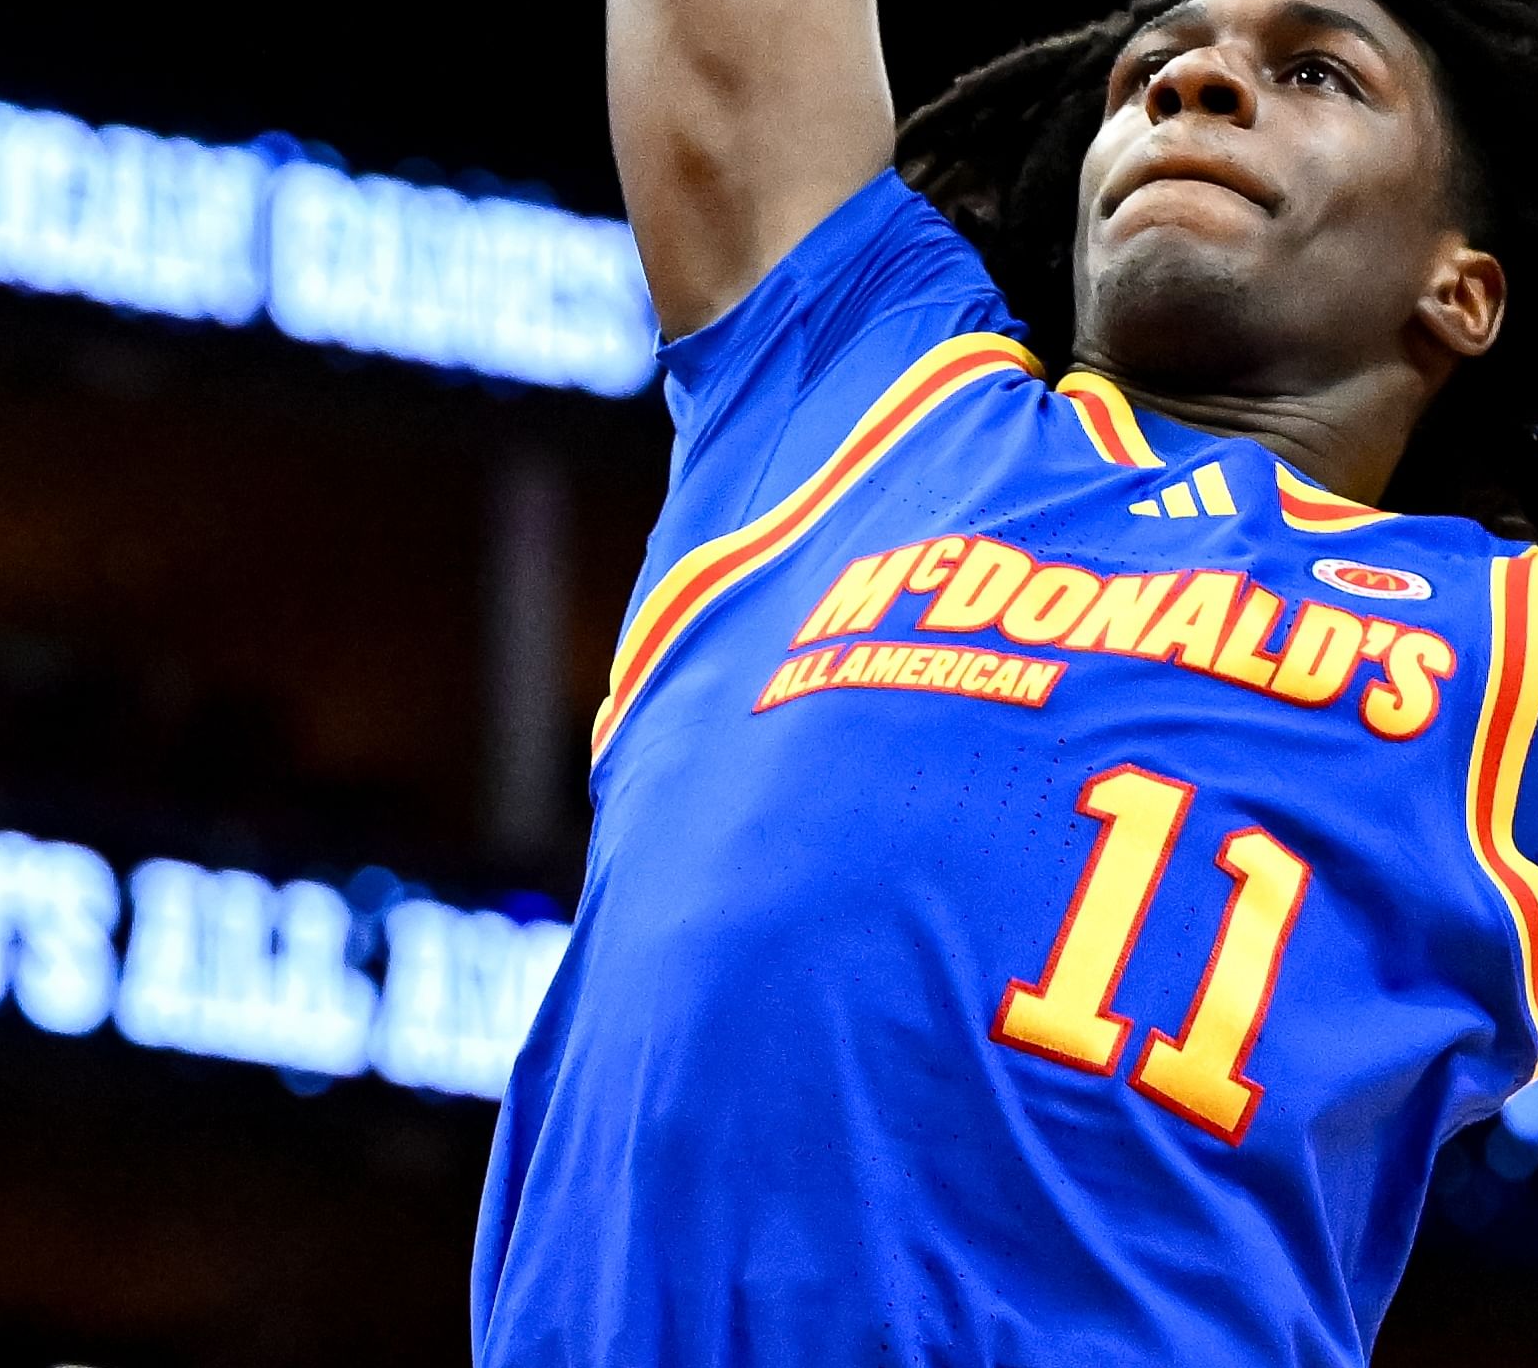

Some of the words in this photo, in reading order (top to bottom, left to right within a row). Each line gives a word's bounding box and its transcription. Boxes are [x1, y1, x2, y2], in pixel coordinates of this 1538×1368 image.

[754, 645, 839, 712] ALL
[834, 642, 1067, 708] AMERICAN
[992, 763, 1311, 1146] 11
